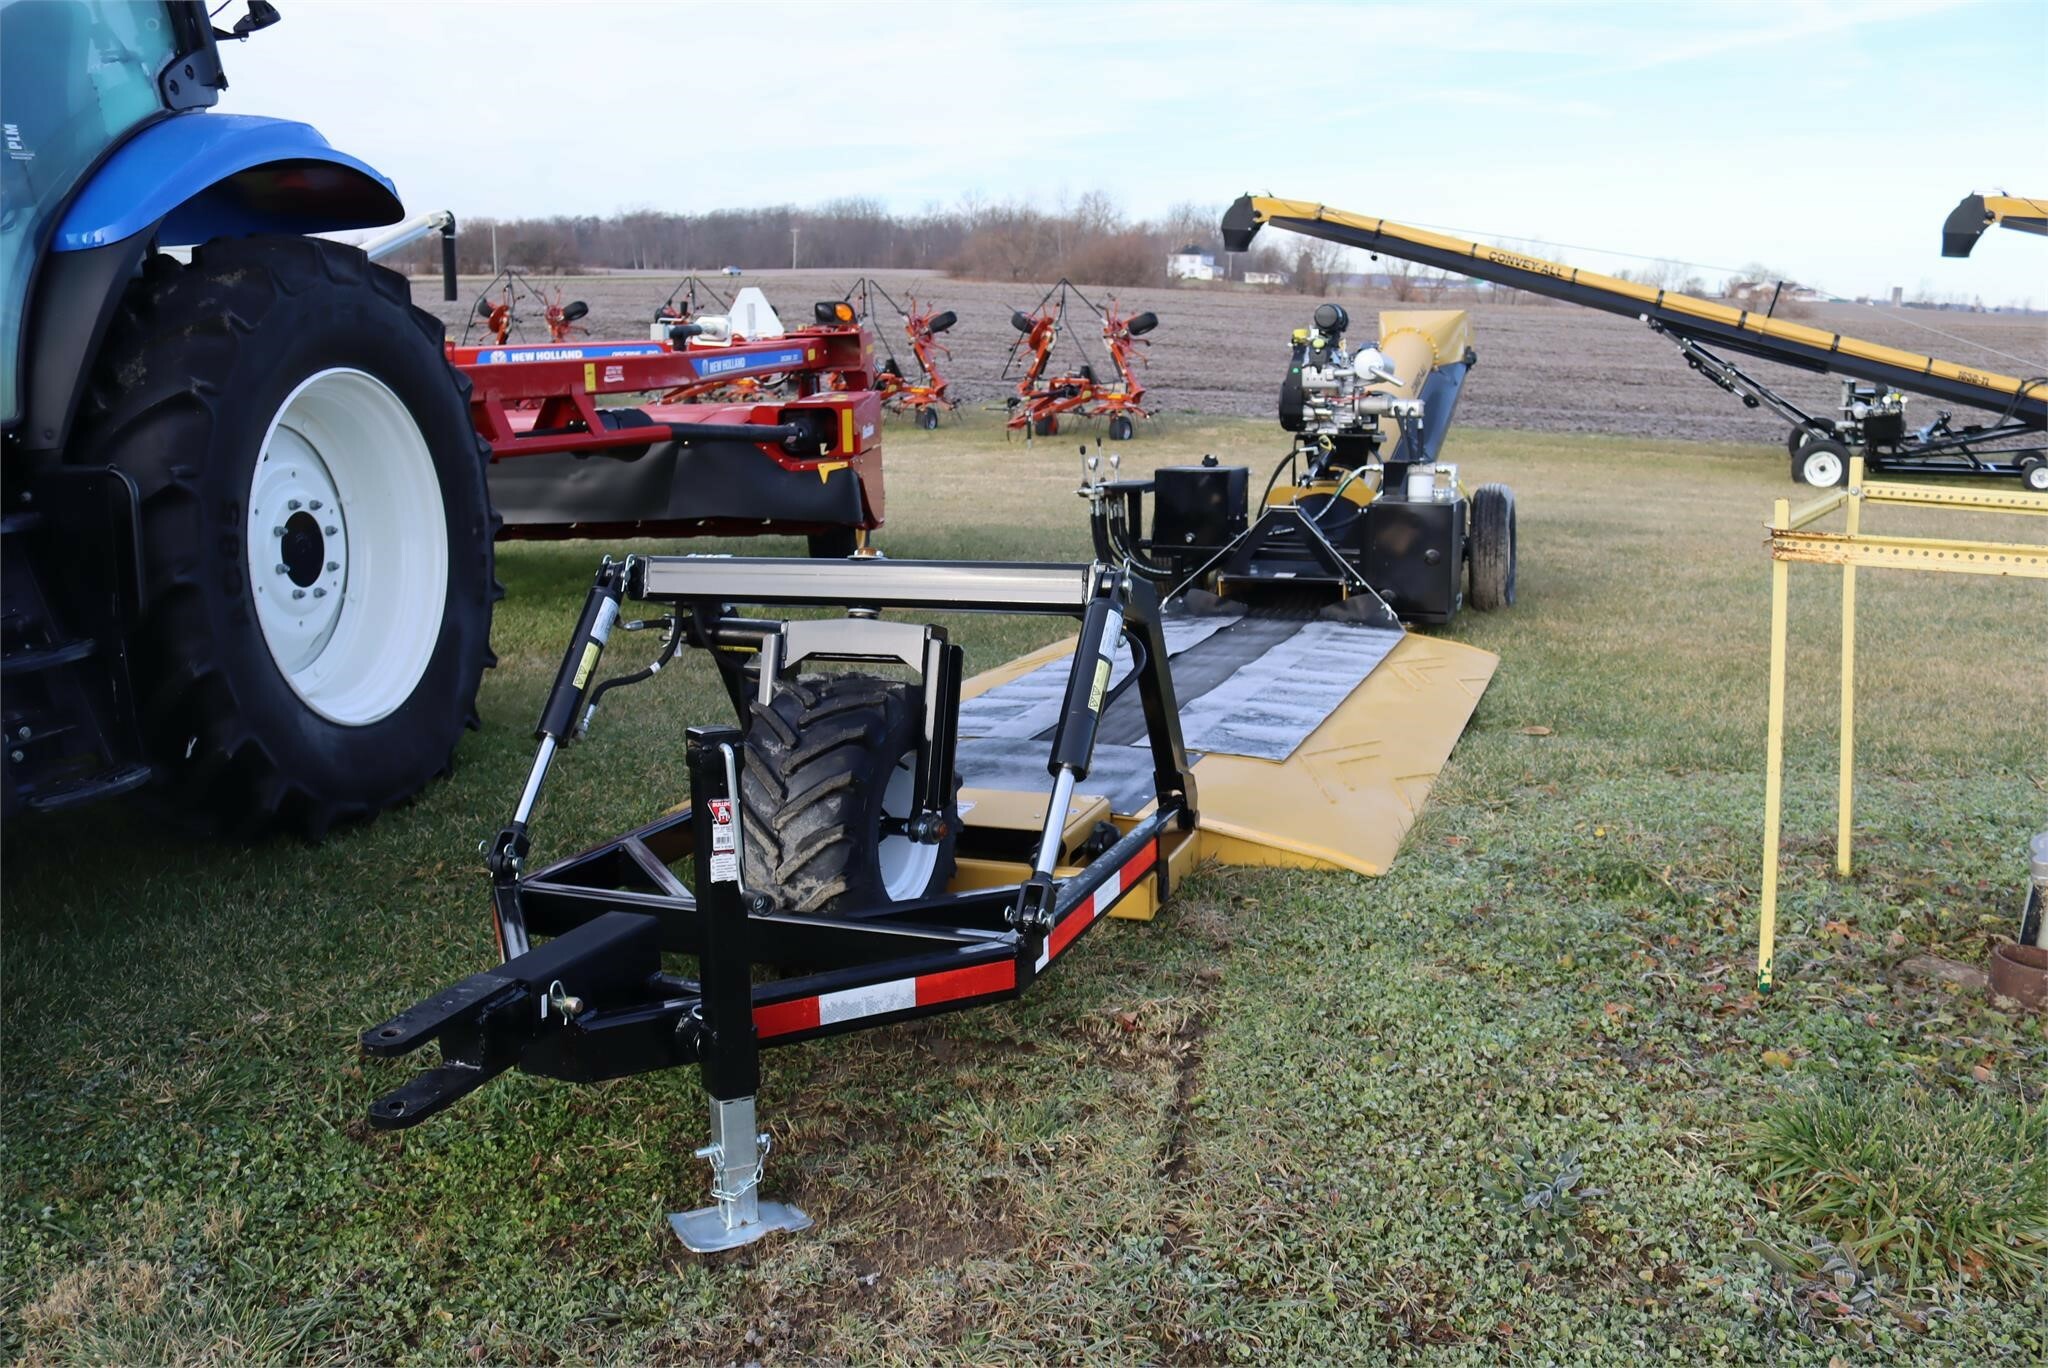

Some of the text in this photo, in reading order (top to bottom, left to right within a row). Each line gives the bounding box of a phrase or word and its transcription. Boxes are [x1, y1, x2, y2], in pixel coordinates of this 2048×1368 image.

[4, 124, 22, 150] PLM
[1488, 251, 1563, 278] CONVEY-ALL
[511, 349, 583, 362] NEW HOLLAND
[709, 357, 746, 373] NEW HOLLAND
